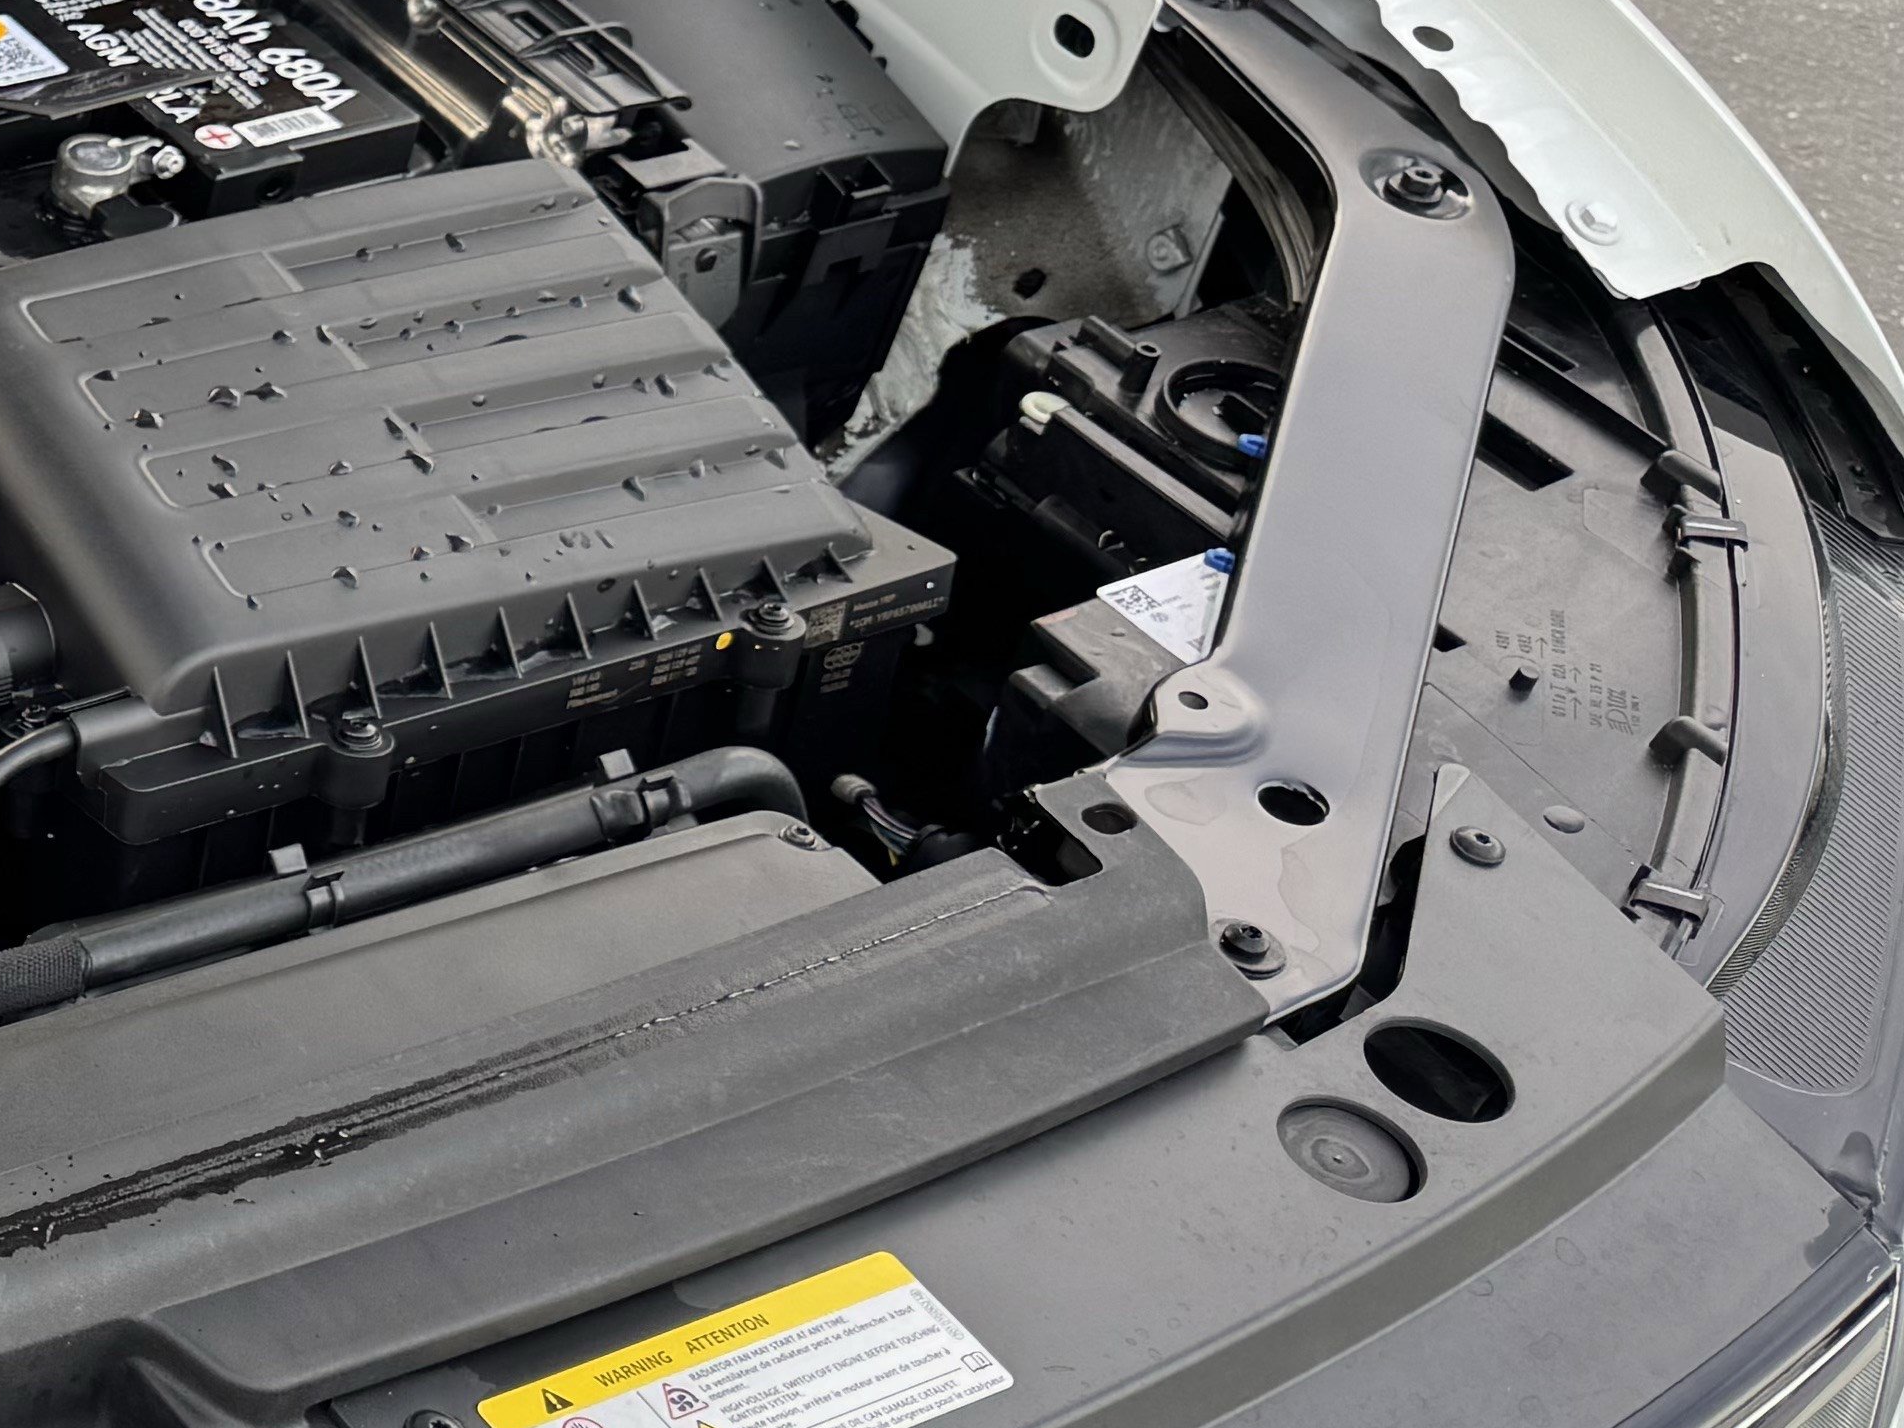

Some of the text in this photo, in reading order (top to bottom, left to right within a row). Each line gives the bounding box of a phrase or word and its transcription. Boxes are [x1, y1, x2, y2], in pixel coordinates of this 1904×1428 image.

[67, 24, 140, 67] AGM
[258, 47, 359, 111] 680A
[593, 1313, 769, 1387] WARNING ATTENTION
[687, 1358, 734, 1381] RADIATOR
[730, 1351, 752, 1365] FAN
[748, 1343, 770, 1359] MAY
[768, 1334, 796, 1351] START
[795, 1329, 808, 1340] AT
[806, 1321, 826, 1336] ANY
[711, 1364, 759, 1387] ventilateur
[757, 1359, 772, 1370] de
[770, 1343, 813, 1364] radiateur
[810, 1335, 832, 1351] peut
[830, 1332, 843, 1341] se
[841, 1315, 888, 1337] déclencher
[892, 1304, 915, 1317] tout
[719, 1398, 744, 1414] HIGH
[781, 1371, 817, 1390] SWITCH
[813, 1364, 832, 1378] OFF
[831, 1352, 866, 1372] ENGINE
[864, 1339, 899, 1359] BEFORE
[895, 1323, 941, 1345] TOUCHING
[829, 1389, 842, 1398] le
[840, 1377, 873, 1394] moteur
[873, 1367, 900, 1382] avant
[897, 1362, 911, 1372] de
[909, 1350, 944, 1368] toucher
[727, 1402, 769, 1424] IGNITION
[846, 1416, 865, 1428] OIL
[862, 1407, 883, 1422] CAN
[880, 1394, 919, 1415] DAMAGE
[889, 1403, 934, 1425] dangereux
[933, 1394, 955, 1410] pour
[951, 1391, 964, 1400] le
